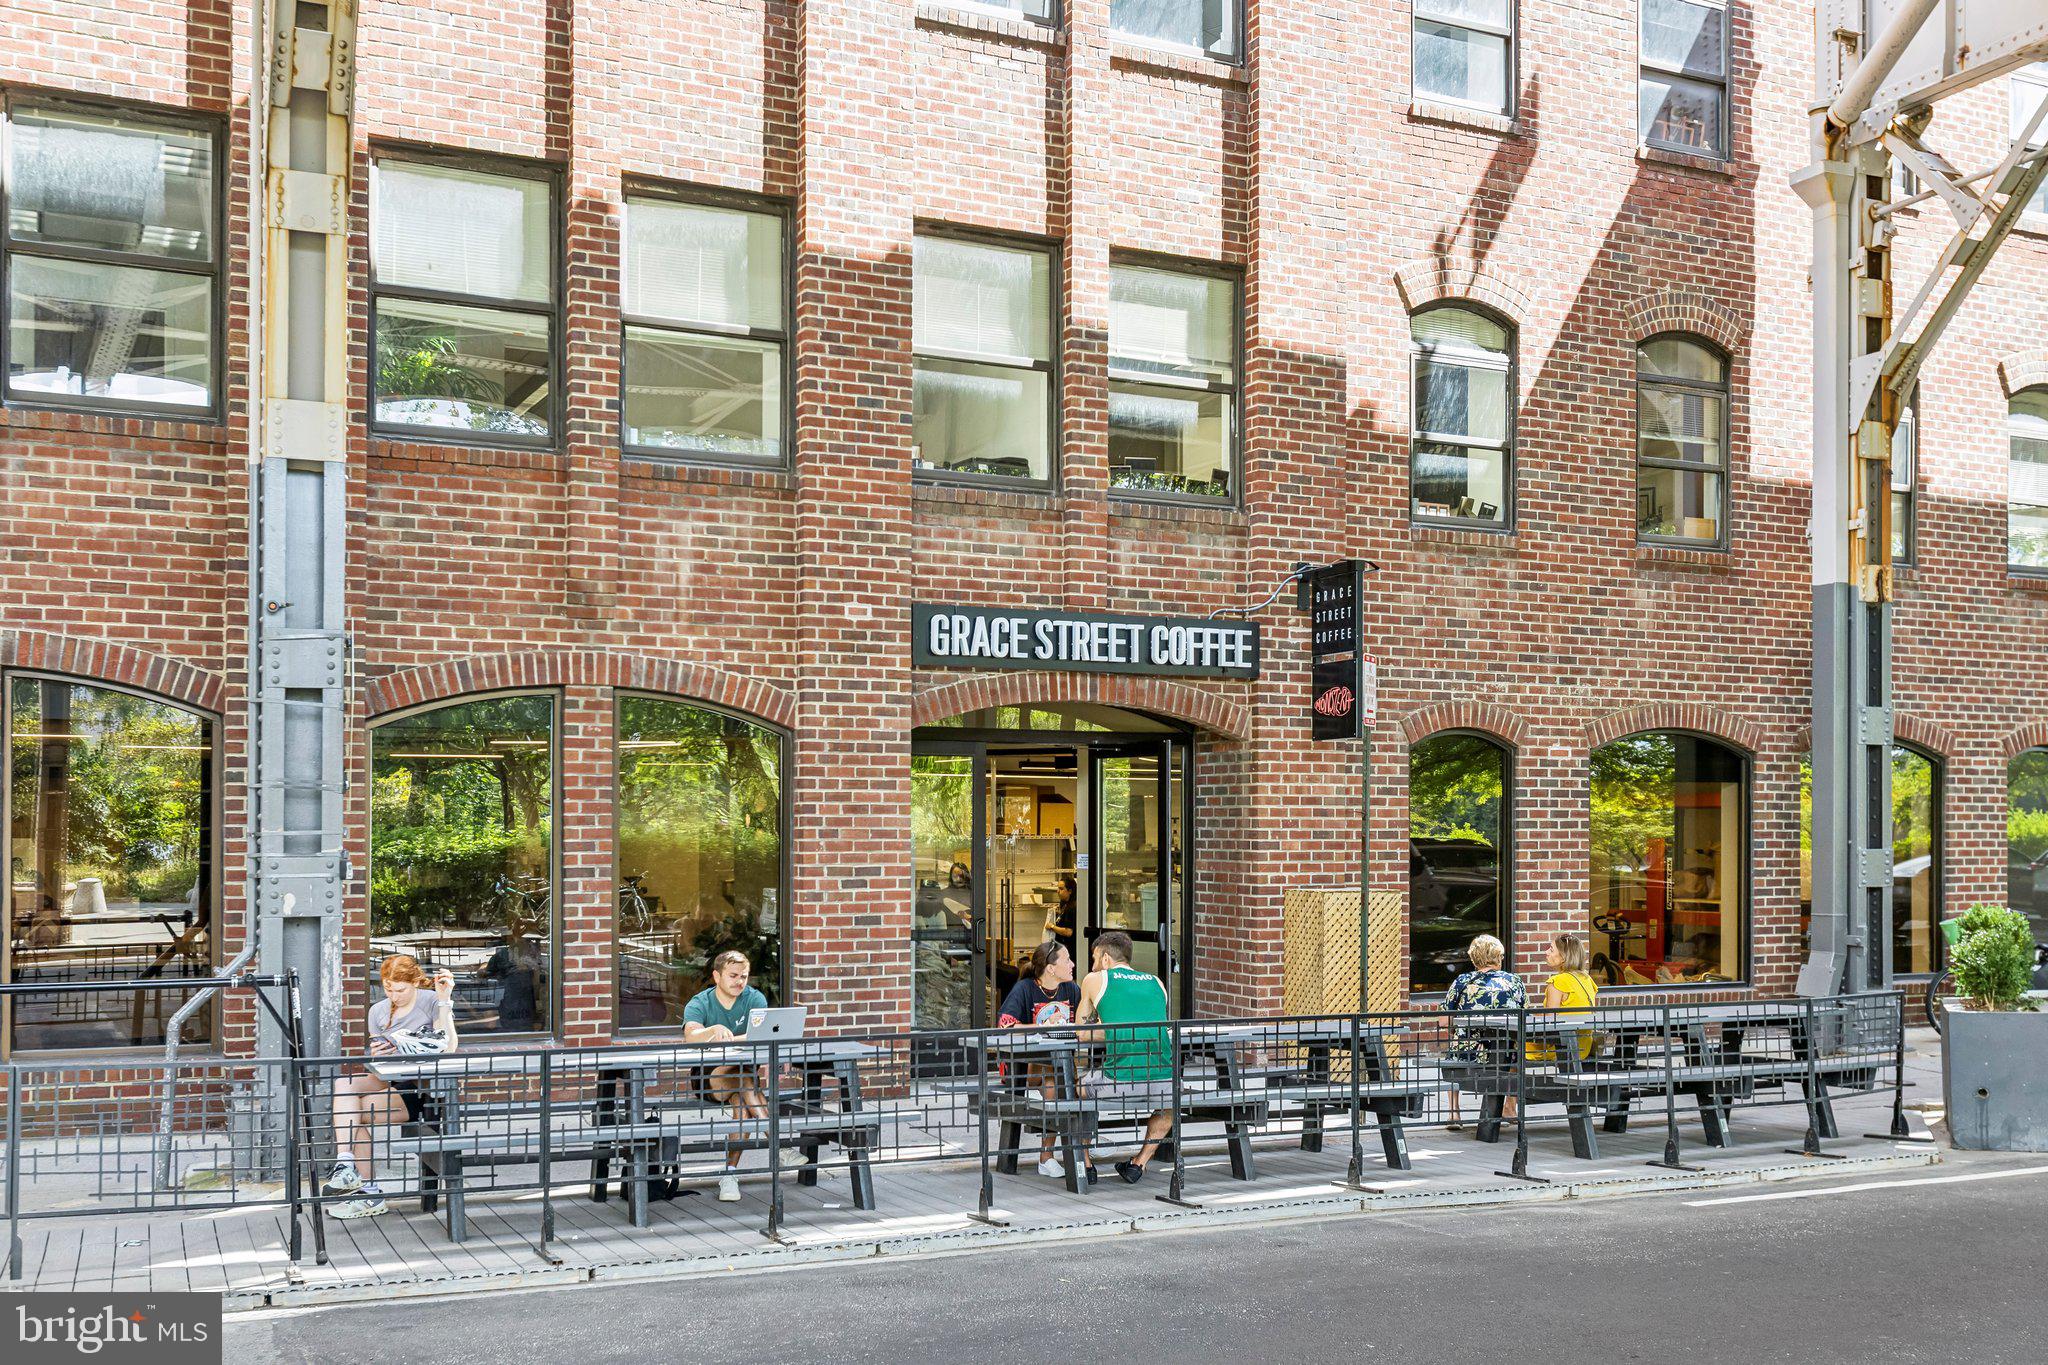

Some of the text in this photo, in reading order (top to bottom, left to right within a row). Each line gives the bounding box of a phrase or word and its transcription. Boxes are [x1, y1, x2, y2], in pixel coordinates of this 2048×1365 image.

[1316, 585, 1352, 603] GRACE
[1316, 606, 1352, 624] STREET
[930, 613, 1253, 668] GRACE STREET COFFEE
[1316, 627, 1352, 644] COFFEE
